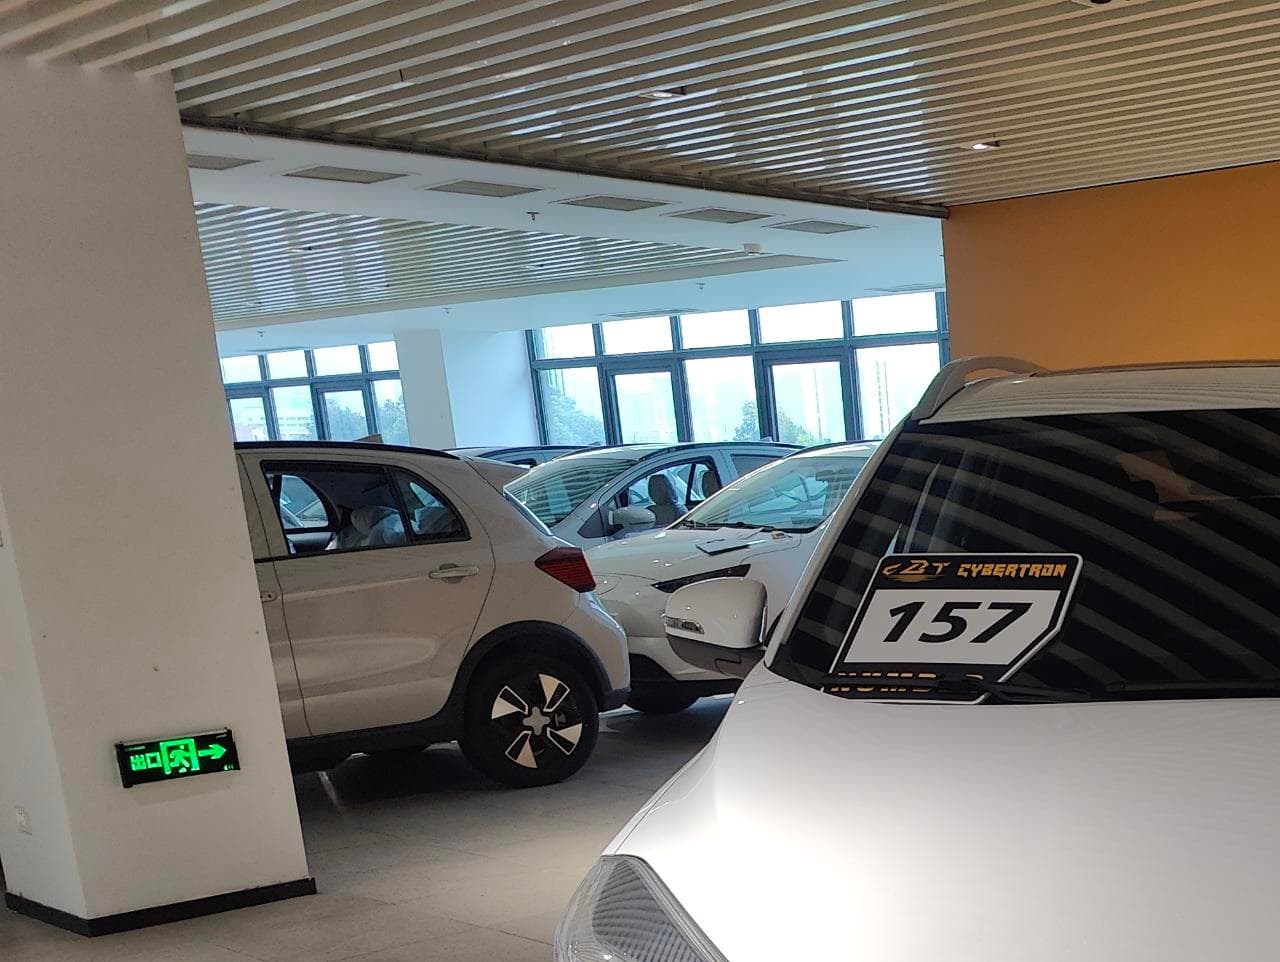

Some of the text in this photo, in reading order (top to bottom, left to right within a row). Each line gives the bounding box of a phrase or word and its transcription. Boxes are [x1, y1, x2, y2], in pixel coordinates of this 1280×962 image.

[957, 563, 1068, 578] CYBERTRON
[882, 601, 1033, 643] 157
[130, 752, 162, 771] 出口
